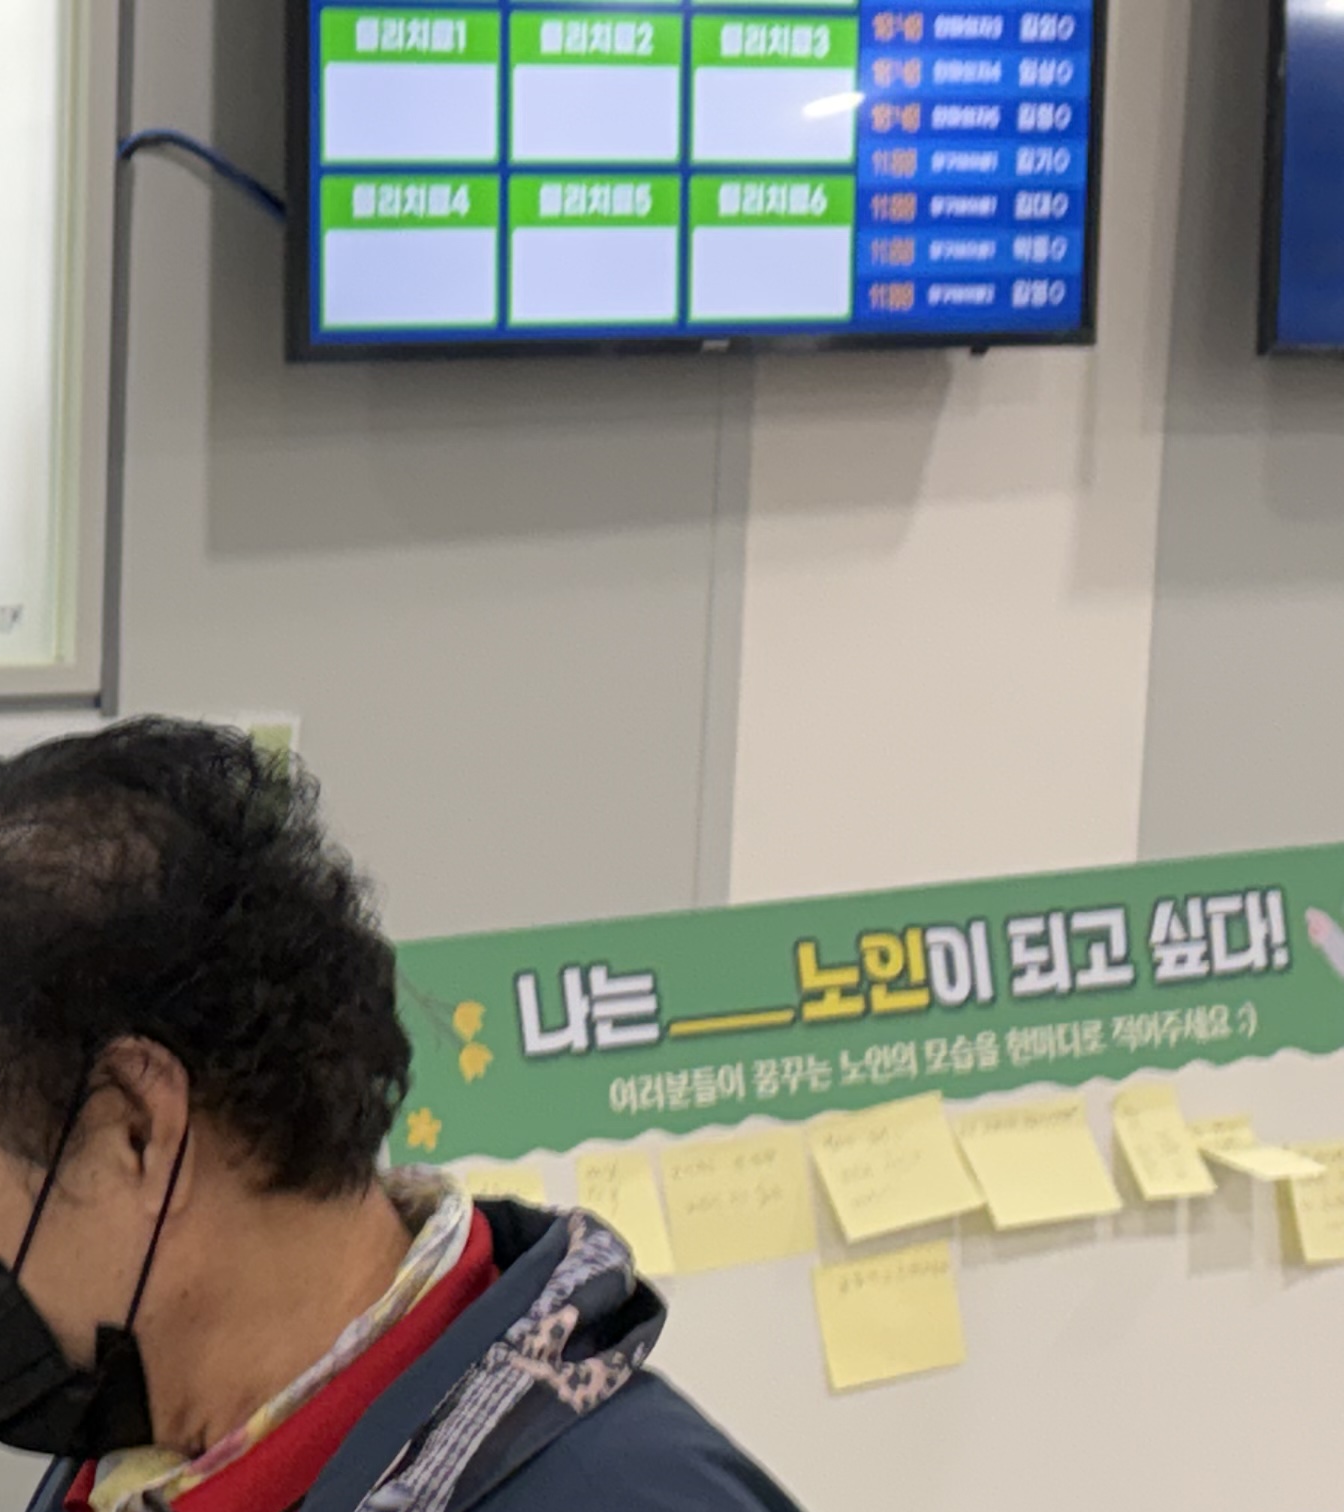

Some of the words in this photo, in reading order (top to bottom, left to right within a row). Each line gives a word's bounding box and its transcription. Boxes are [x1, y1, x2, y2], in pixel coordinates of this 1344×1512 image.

[515, 962, 660, 1058] 나는
[796, 919, 994, 1020] 노인이
[1007, 905, 1134, 998] 되고
[1149, 888, 1292, 984] 싶다!
[609, 1062, 746, 1115] 여러분들이
[752, 1053, 833, 1099] 꿈꾸는
[839, 1041, 919, 1087] 노인의
[924, 1029, 1001, 1075] 모습을
[1005, 1018, 1106, 1070] 한마디로
[1111, 1004, 1233, 1053] 적어주세요
